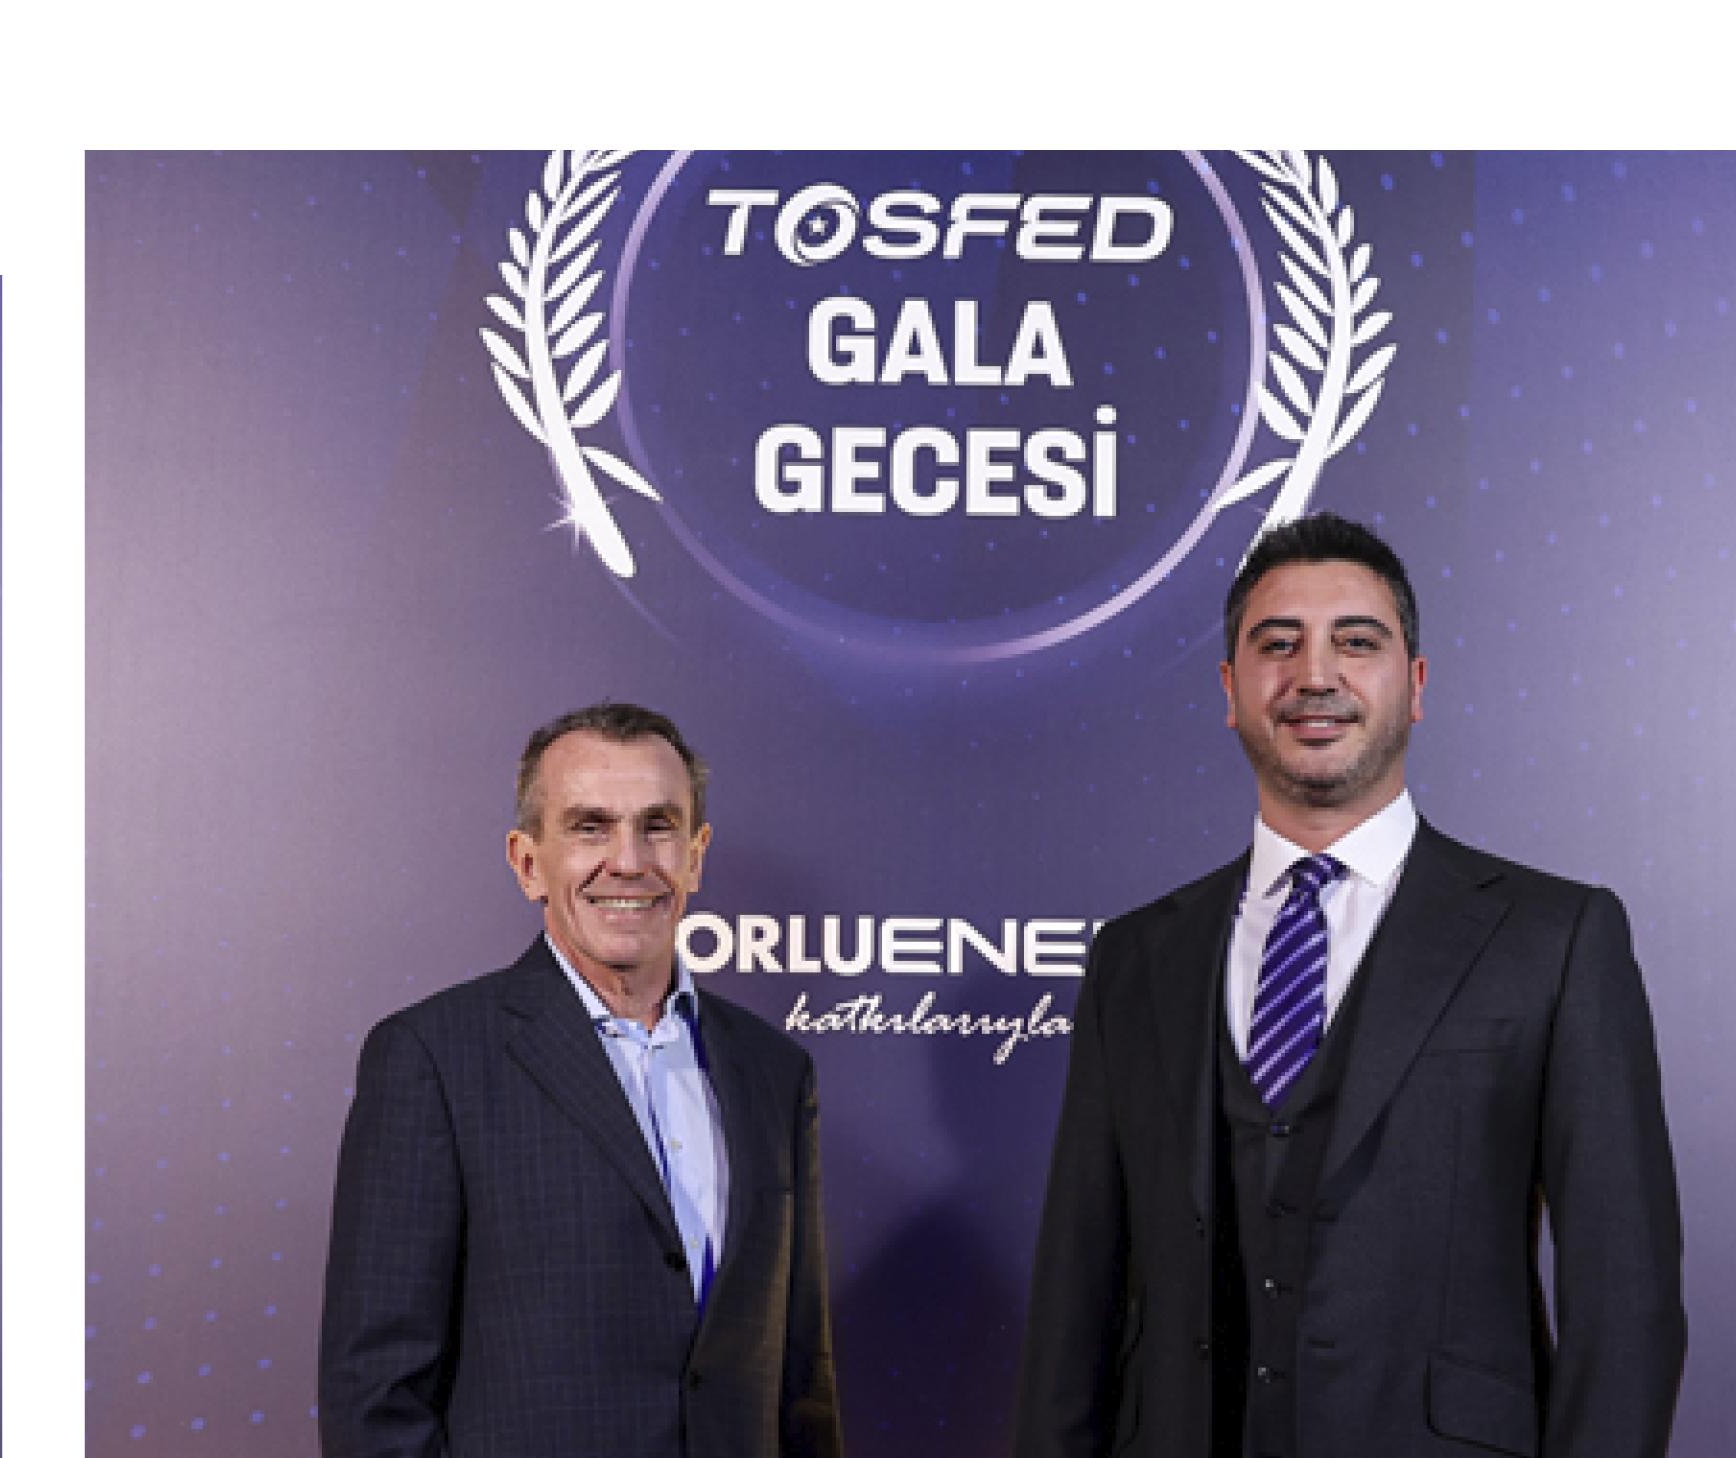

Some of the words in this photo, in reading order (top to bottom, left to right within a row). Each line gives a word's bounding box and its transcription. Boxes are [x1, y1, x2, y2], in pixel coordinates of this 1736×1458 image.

[708, 184, 1175, 266] TOSFED
[807, 297, 1075, 388] GALA
[754, 404, 1117, 517] GECESİ
[675, 913, 1102, 977] ORLUENE
